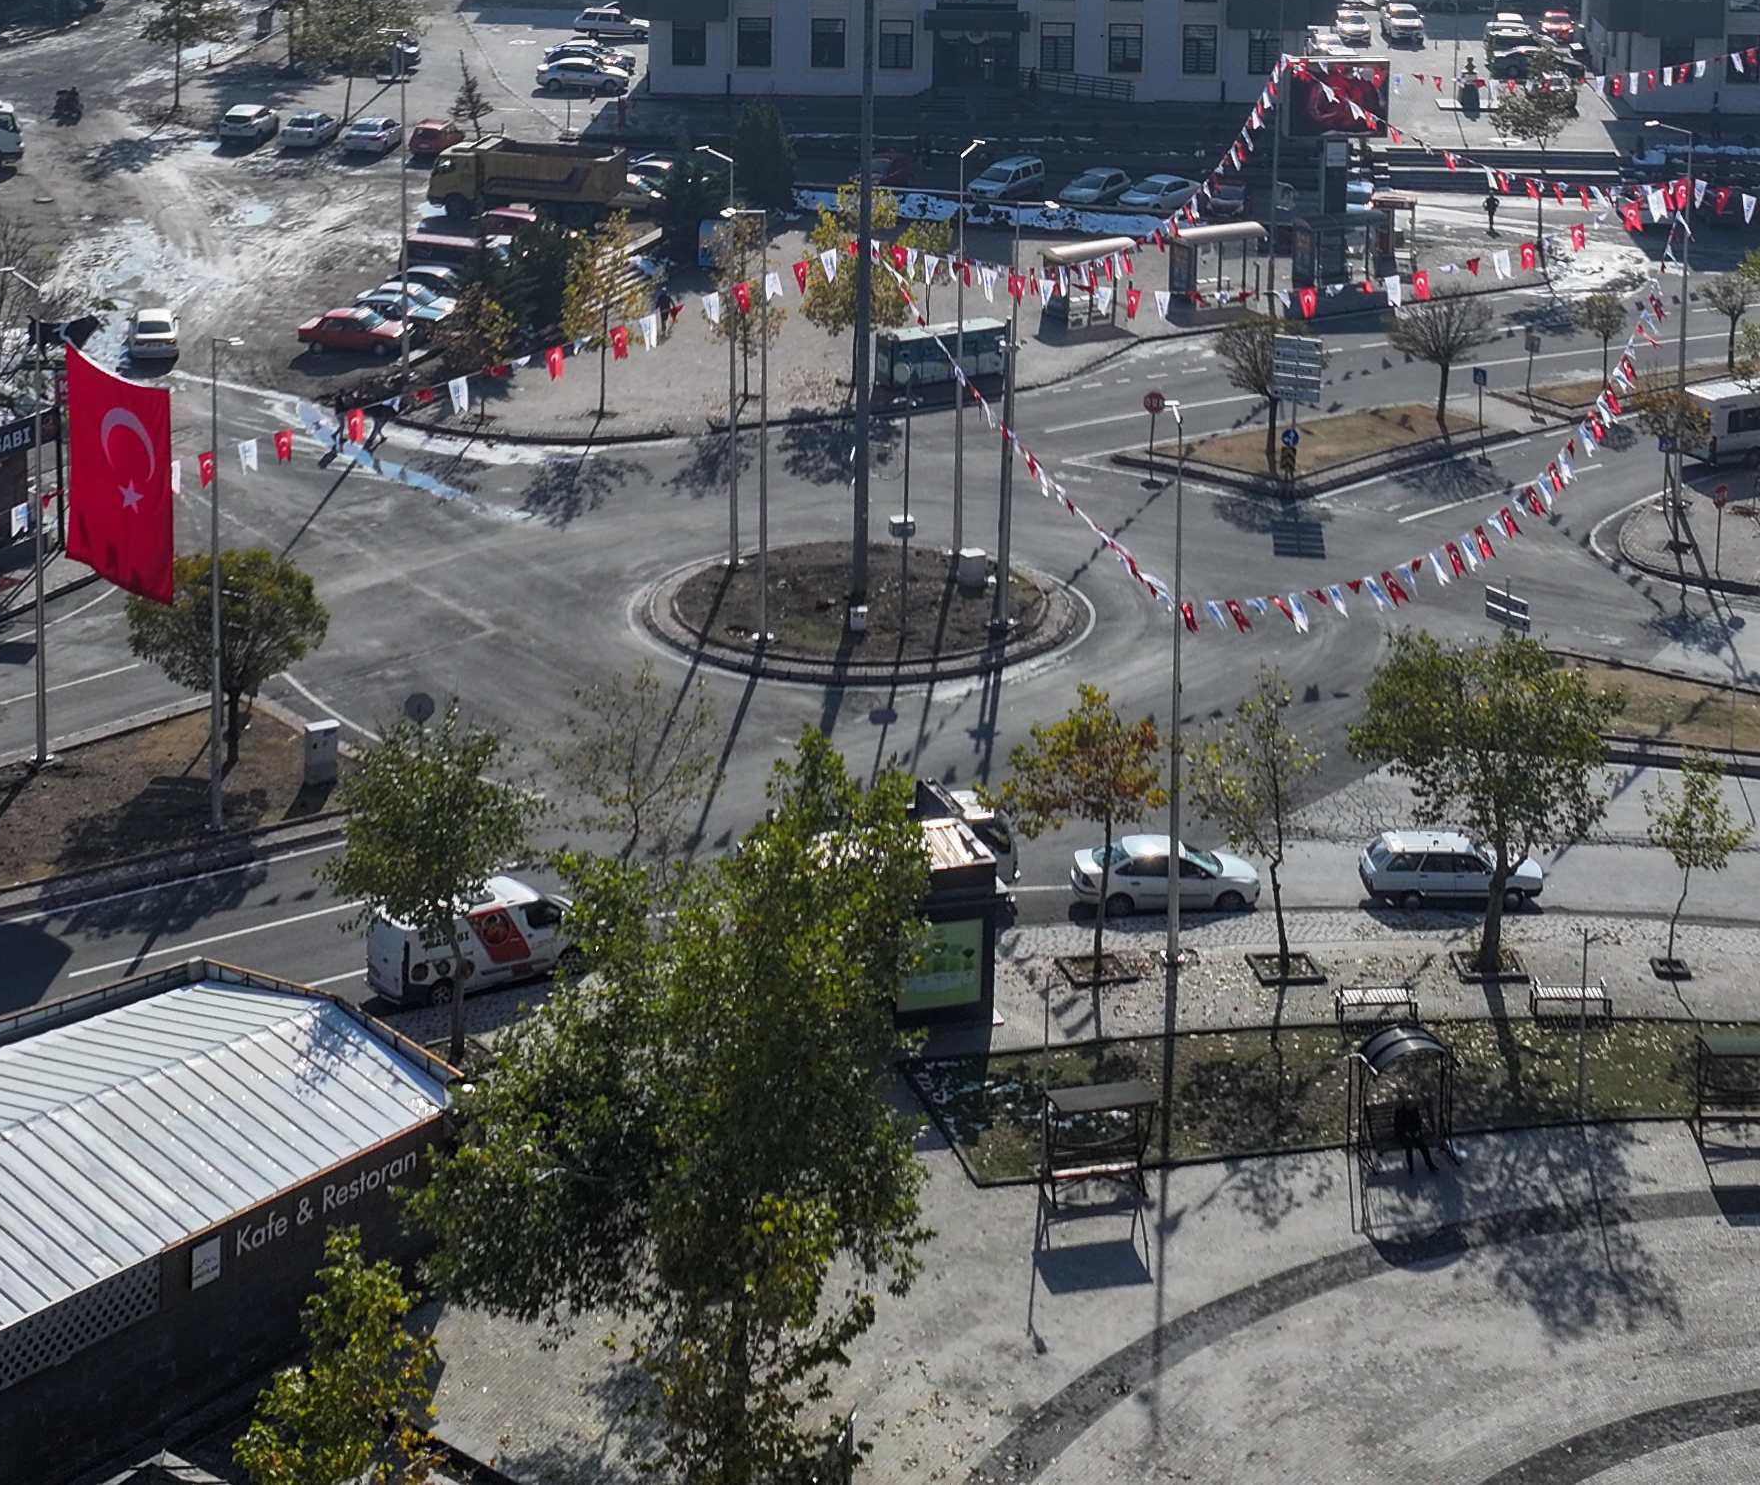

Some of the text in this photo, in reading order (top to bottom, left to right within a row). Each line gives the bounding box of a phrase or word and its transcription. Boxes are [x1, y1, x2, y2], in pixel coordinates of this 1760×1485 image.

[236, 1151, 417, 1257] Kafe & Restoran
